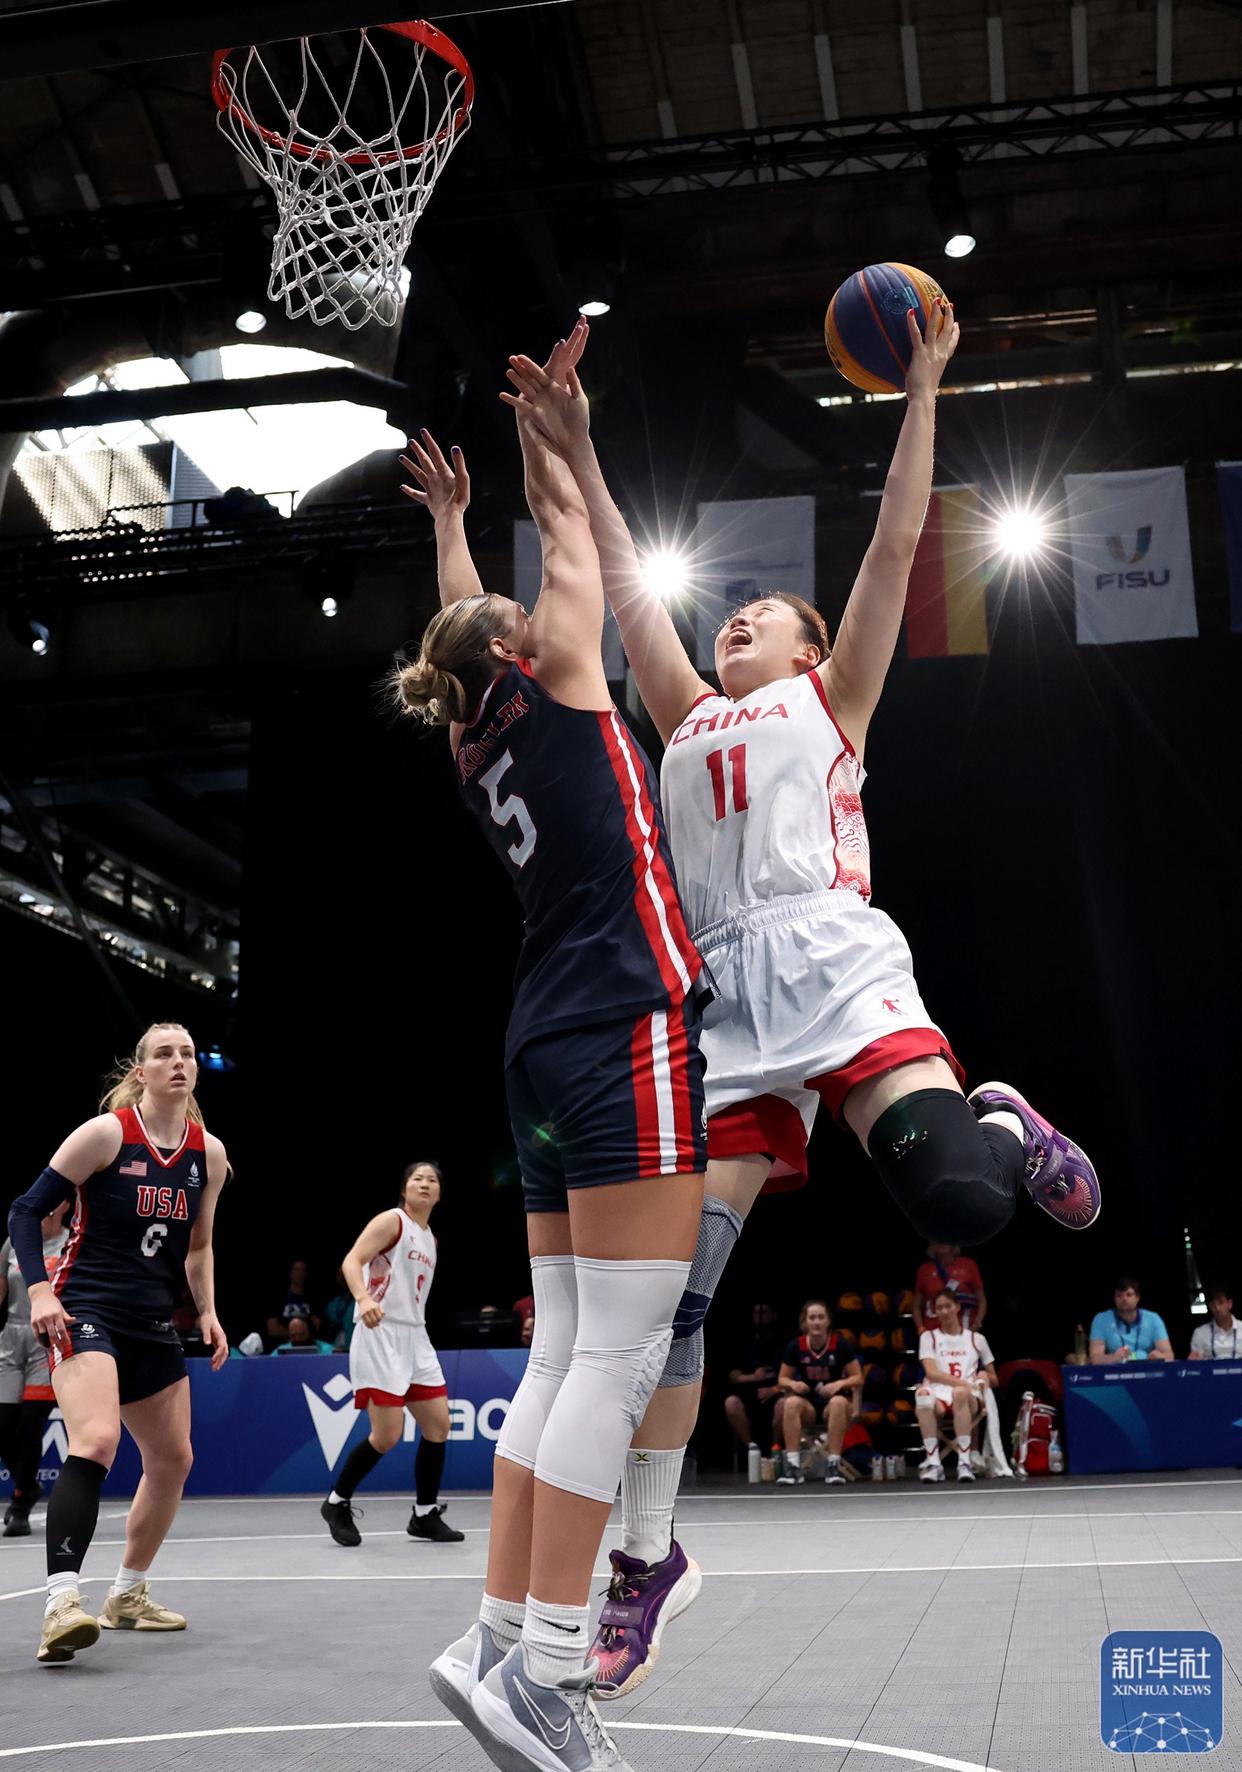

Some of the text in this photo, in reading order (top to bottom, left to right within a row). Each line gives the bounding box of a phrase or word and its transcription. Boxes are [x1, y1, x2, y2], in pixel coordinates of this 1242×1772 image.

[1096, 568, 1170, 590] FISU
[673, 703, 788, 746] CHINA
[706, 743, 749, 822] 11
[478, 747, 537, 868] 5
[136, 1185, 188, 1220] USA
[141, 1223, 168, 1257] 6
